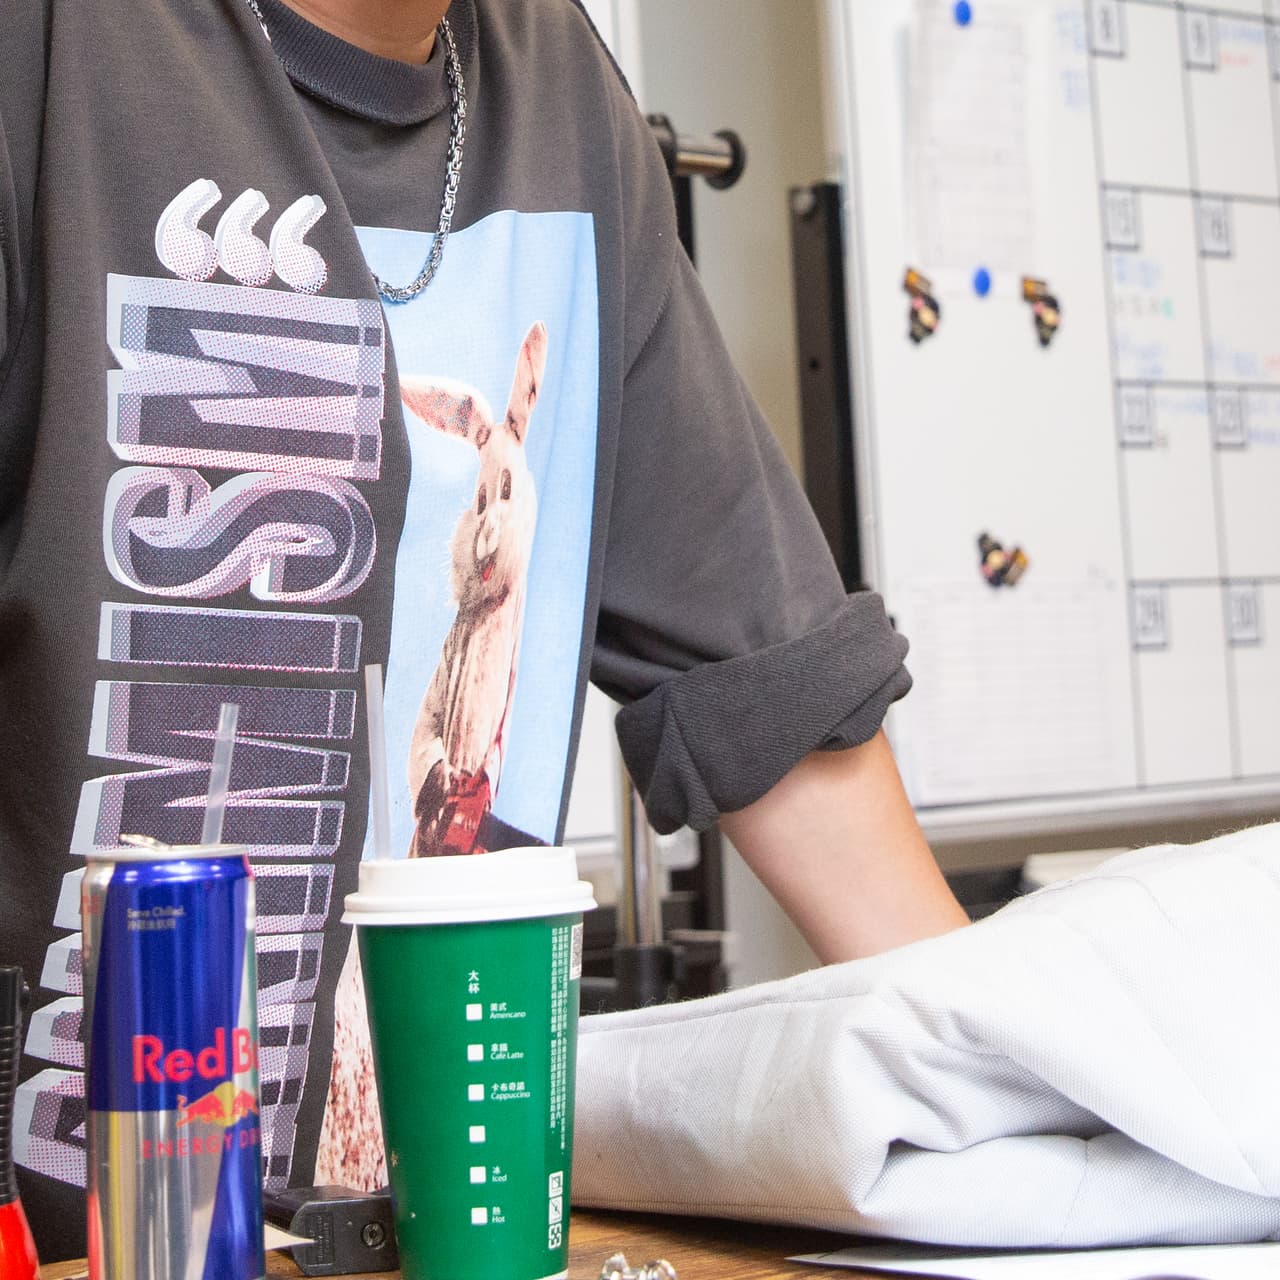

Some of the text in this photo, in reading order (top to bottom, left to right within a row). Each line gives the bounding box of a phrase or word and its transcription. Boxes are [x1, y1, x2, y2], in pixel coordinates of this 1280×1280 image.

[468, 970, 480, 994] 大杯
[132, 1027, 226, 1083] Red
[142, 1132, 232, 1159] ENERGY
[492, 1174, 508, 1182] Iced
[492, 1215, 505, 1223] Hot
